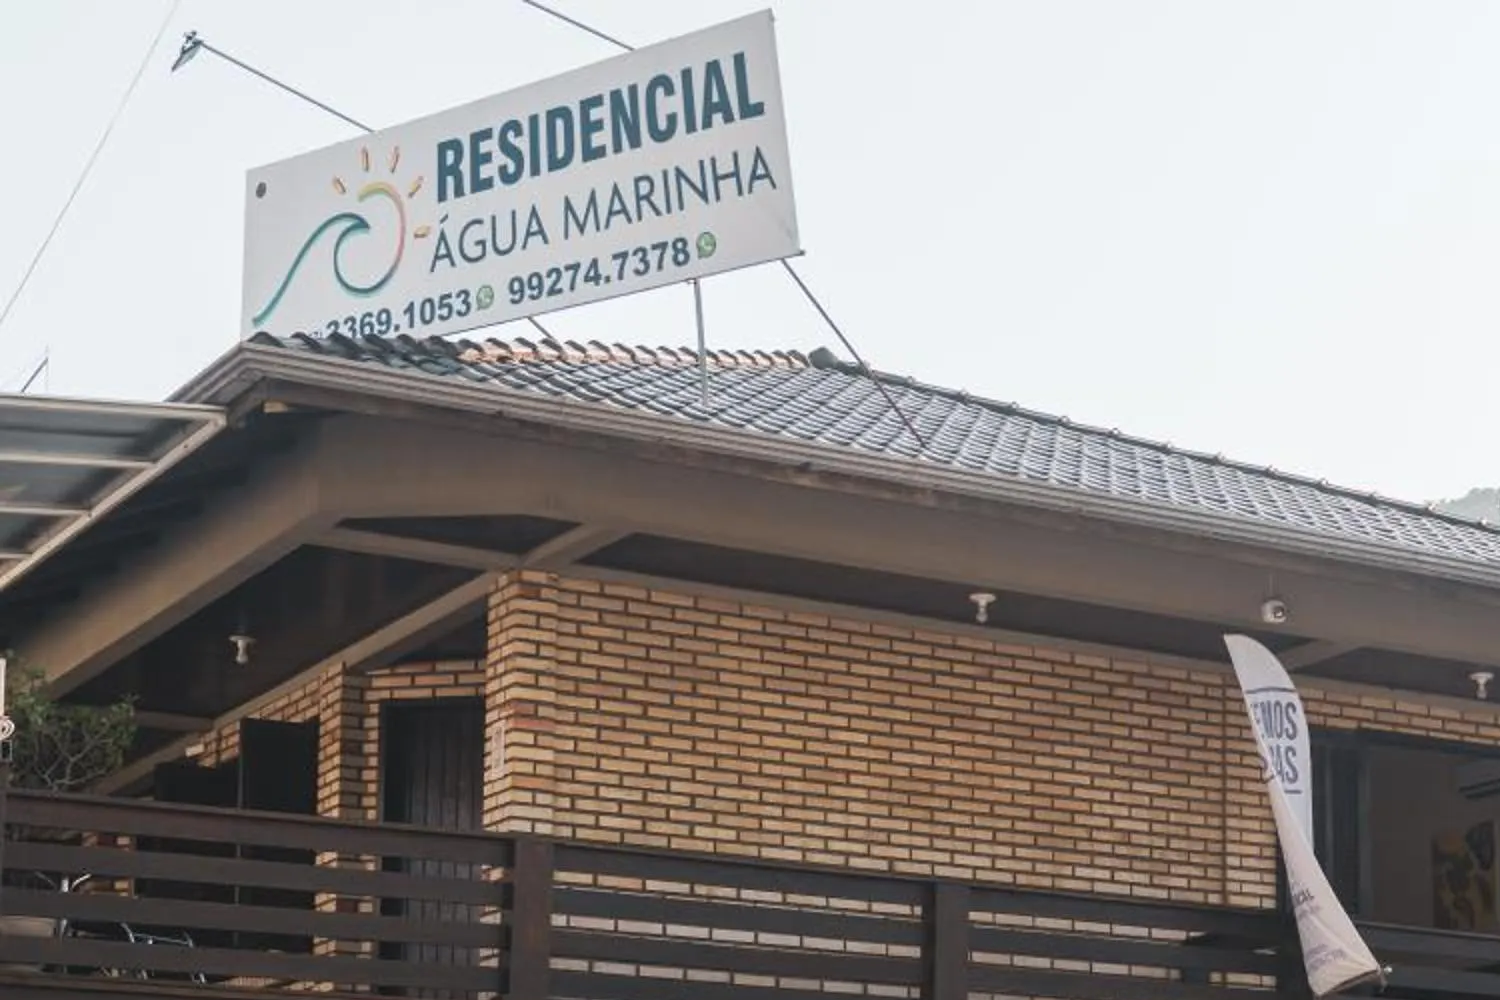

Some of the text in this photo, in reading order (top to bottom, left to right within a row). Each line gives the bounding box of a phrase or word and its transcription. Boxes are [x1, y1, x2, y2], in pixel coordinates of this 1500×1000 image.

[436, 50, 766, 203] RESIDENCIAL
[428, 145, 778, 273] ÁGUA MARINHA
[507, 236, 691, 305] 99274.7378
